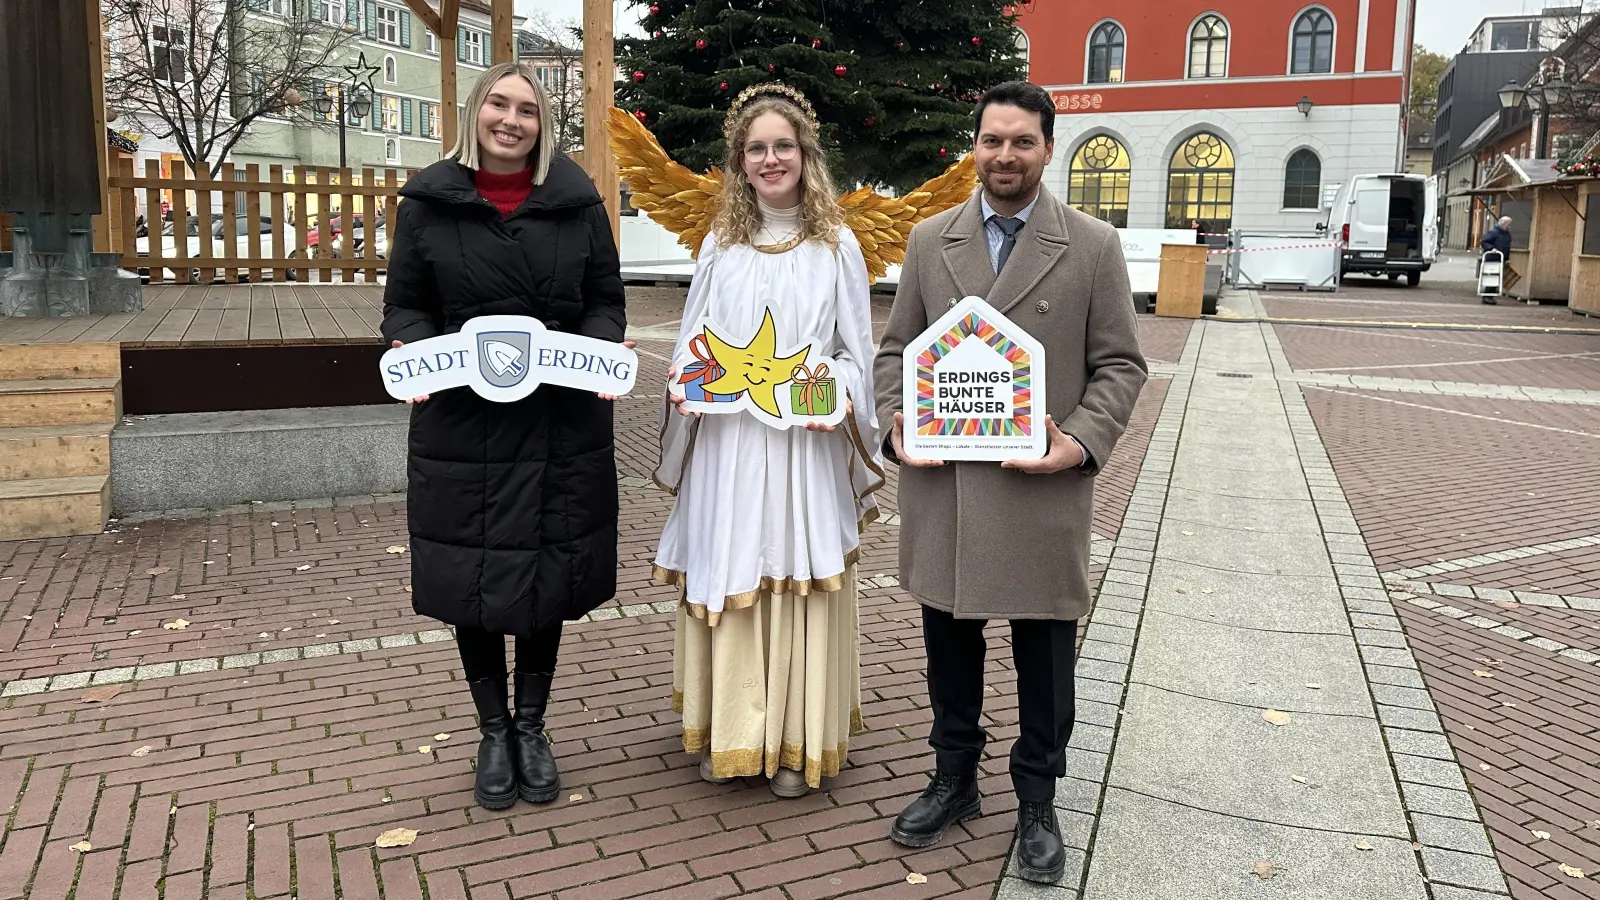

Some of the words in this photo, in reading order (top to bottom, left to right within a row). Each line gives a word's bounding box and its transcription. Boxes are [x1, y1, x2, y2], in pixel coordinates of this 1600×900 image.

[387, 349, 470, 384] STADT
[537, 348, 631, 381] ERDING
[938, 371, 1011, 384] ERDINGS
[938, 387, 994, 398] BUNTE
[939, 399, 1005, 413] HÄUSER
